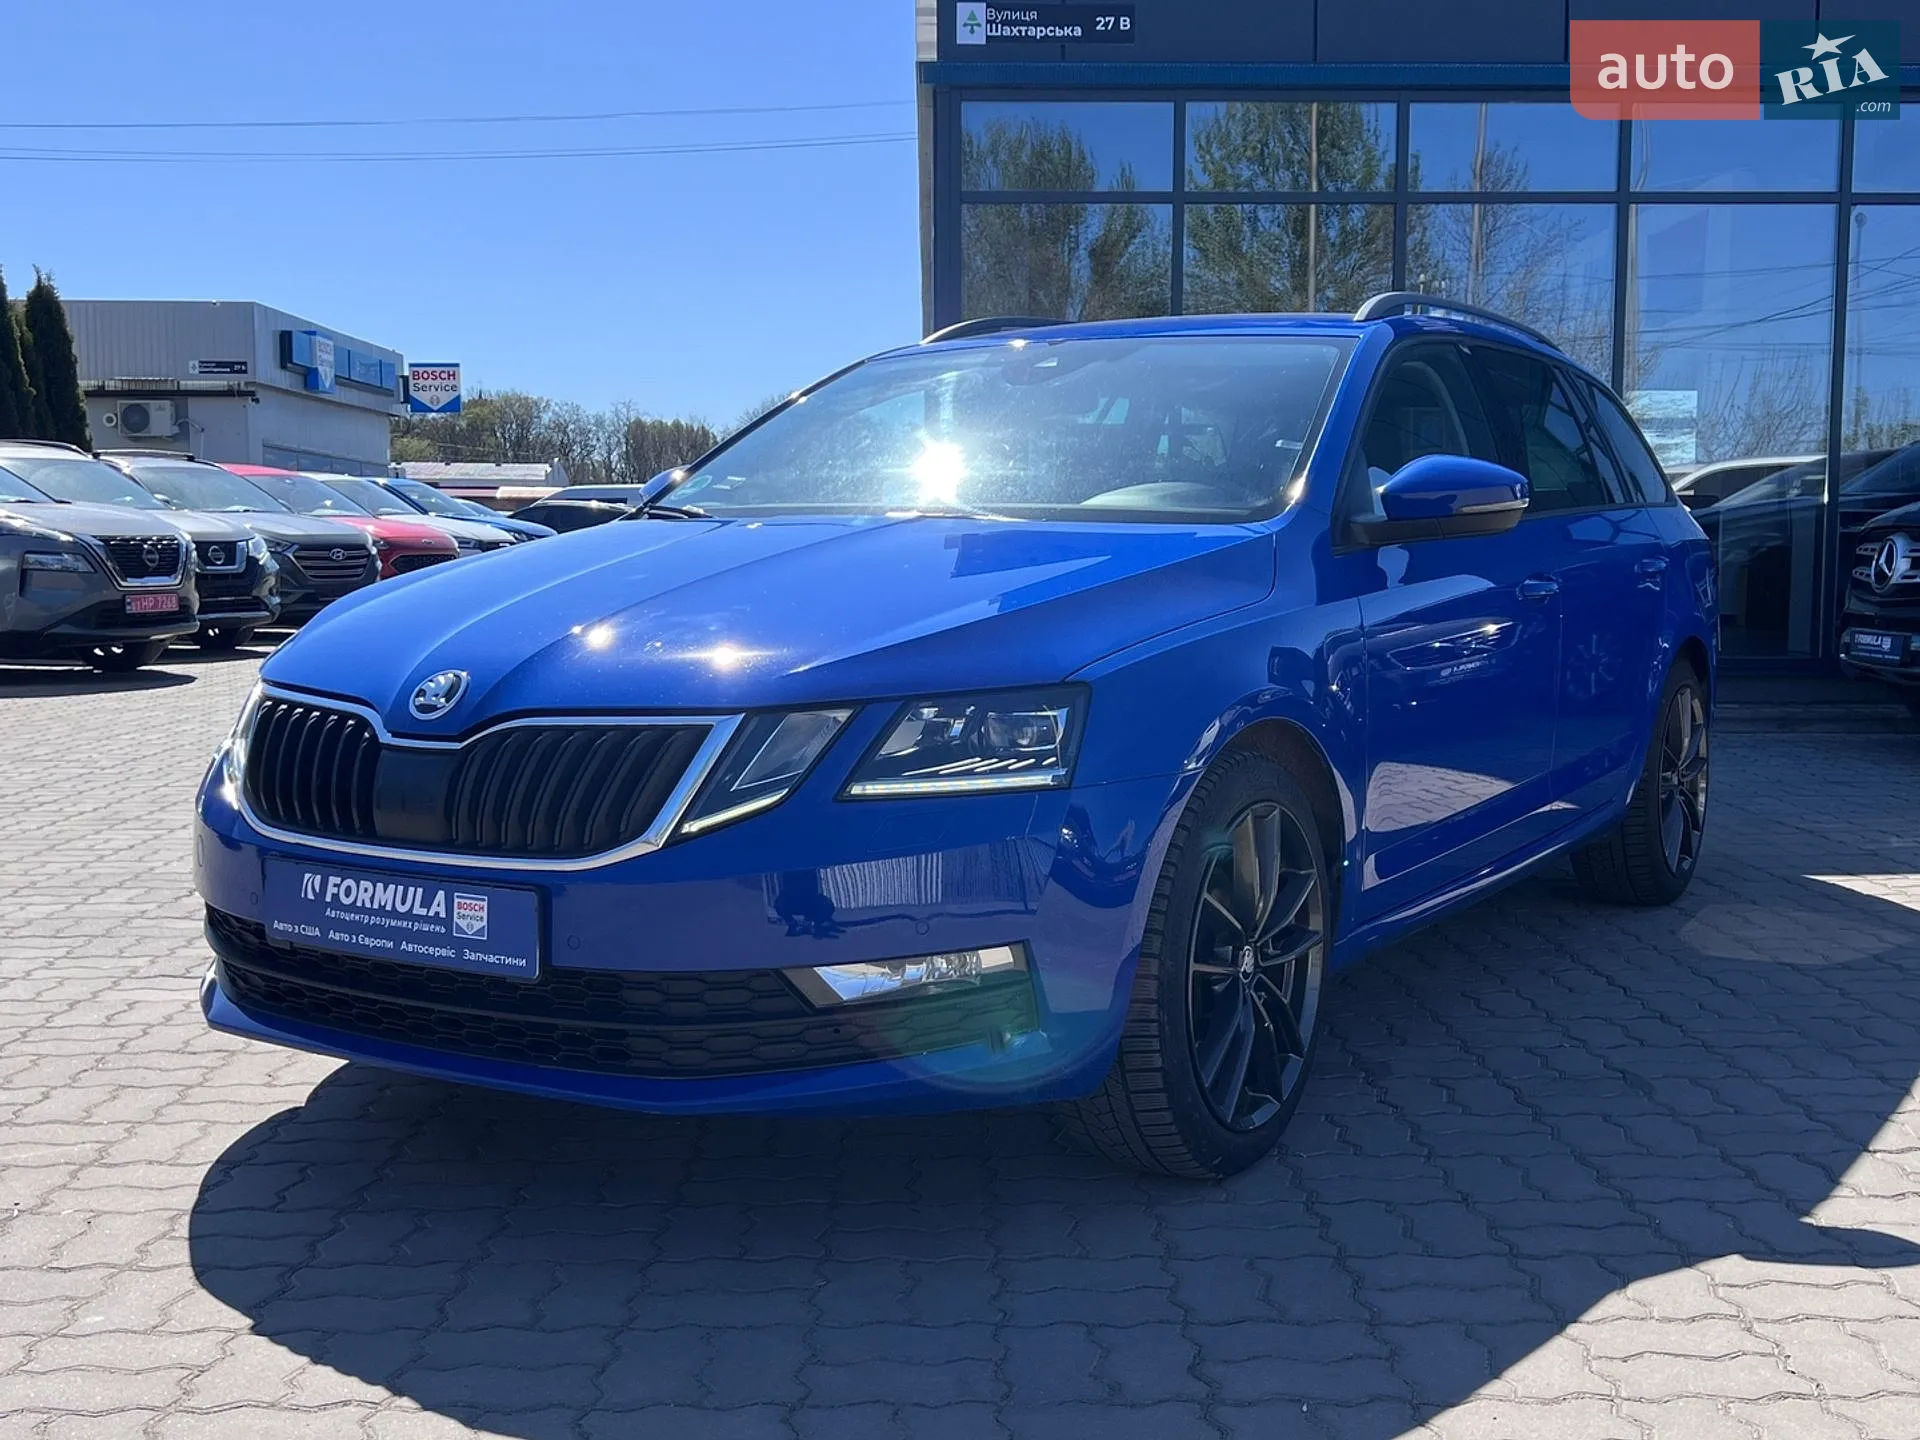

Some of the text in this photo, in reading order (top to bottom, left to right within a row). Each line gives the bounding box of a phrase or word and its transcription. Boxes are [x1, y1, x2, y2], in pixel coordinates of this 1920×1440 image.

[987, 8, 1037, 21] Вулиця
[987, 23, 1082, 39] Шахтарська
[1095, 16, 1115, 31] 27
[411, 370, 456, 381] BOSCH
[412, 382, 458, 392] Service
[325, 876, 447, 918] FORMULA
[456, 900, 485, 912] BOSCH
[325, 908, 446, 934] Автоцентр розумних рішень
[456, 911, 485, 922] Service
[273, 920, 321, 937] Авто з США
[328, 929, 394, 949] Авто з Європи
[400, 941, 456, 958] Автосервіс
[462, 949, 527, 967] Запчастини
